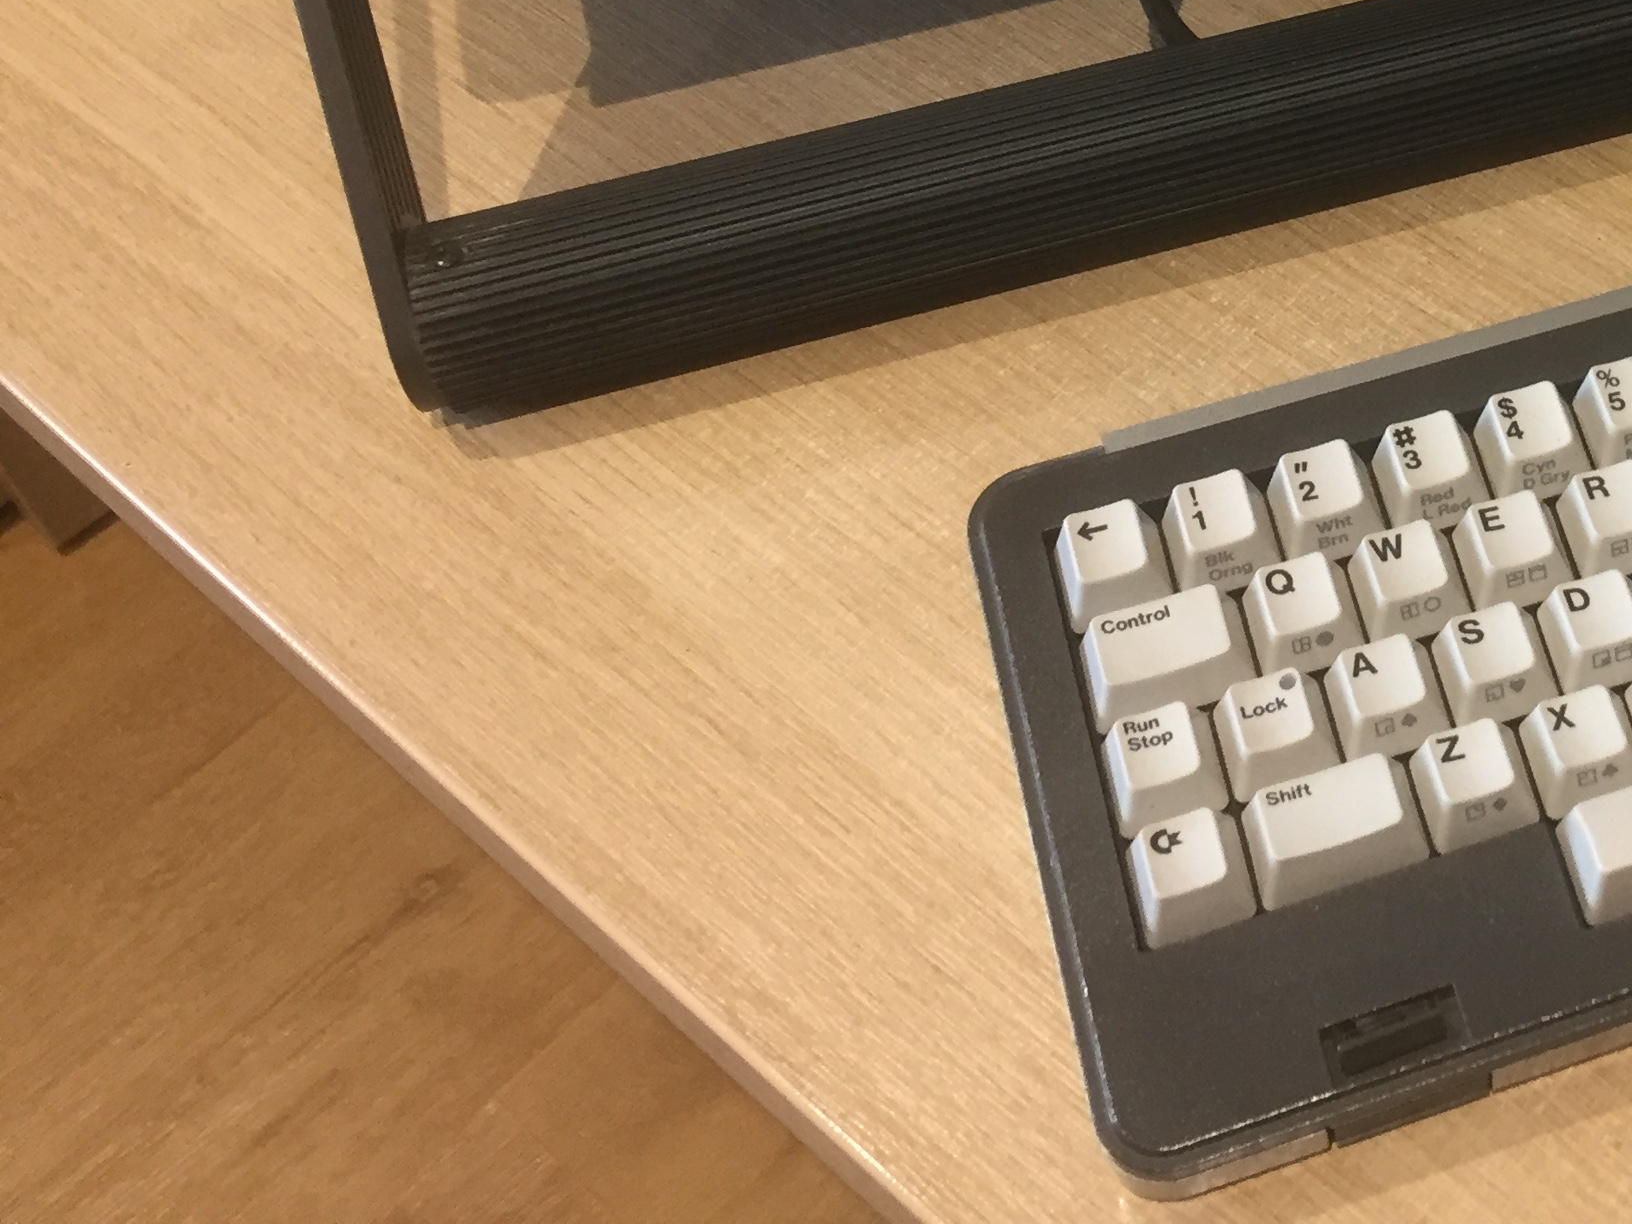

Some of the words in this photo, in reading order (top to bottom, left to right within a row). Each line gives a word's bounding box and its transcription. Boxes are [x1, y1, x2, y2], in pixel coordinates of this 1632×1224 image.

[1595, 368, 1621, 389] %
[1496, 396, 1518, 419] $
[1608, 391, 1627, 411] 5
[1393, 425, 1417, 448] #
[1506, 420, 1525, 441] 4
[1403, 449, 1423, 470] 3
[1522, 458, 1556, 478] Cyn
[1298, 480, 1319, 502] 2
[1420, 486, 1455, 507] Red
[1582, 475, 1611, 500] R
[1191, 510, 1208, 530] 1
[1315, 515, 1353, 534] Wht
[1478, 506, 1505, 533] E
[1317, 532, 1350, 550] Brn
[1369, 533, 1403, 563] W
[1204, 549, 1235, 568] Blk
[1208, 562, 1254, 583] Orng
[1264, 569, 1296, 596] Q
[1562, 587, 1591, 612] D
[1100, 604, 1171, 635] Control
[1457, 619, 1485, 646] S
[1352, 652, 1379, 678] A
[1239, 696, 1289, 720] Lock
[1547, 703, 1576, 732] X
[1122, 716, 1161, 736] Run
[1127, 728, 1174, 753] Stop
[1435, 734, 1467, 764] Z
[1264, 782, 1313, 807] Shift
